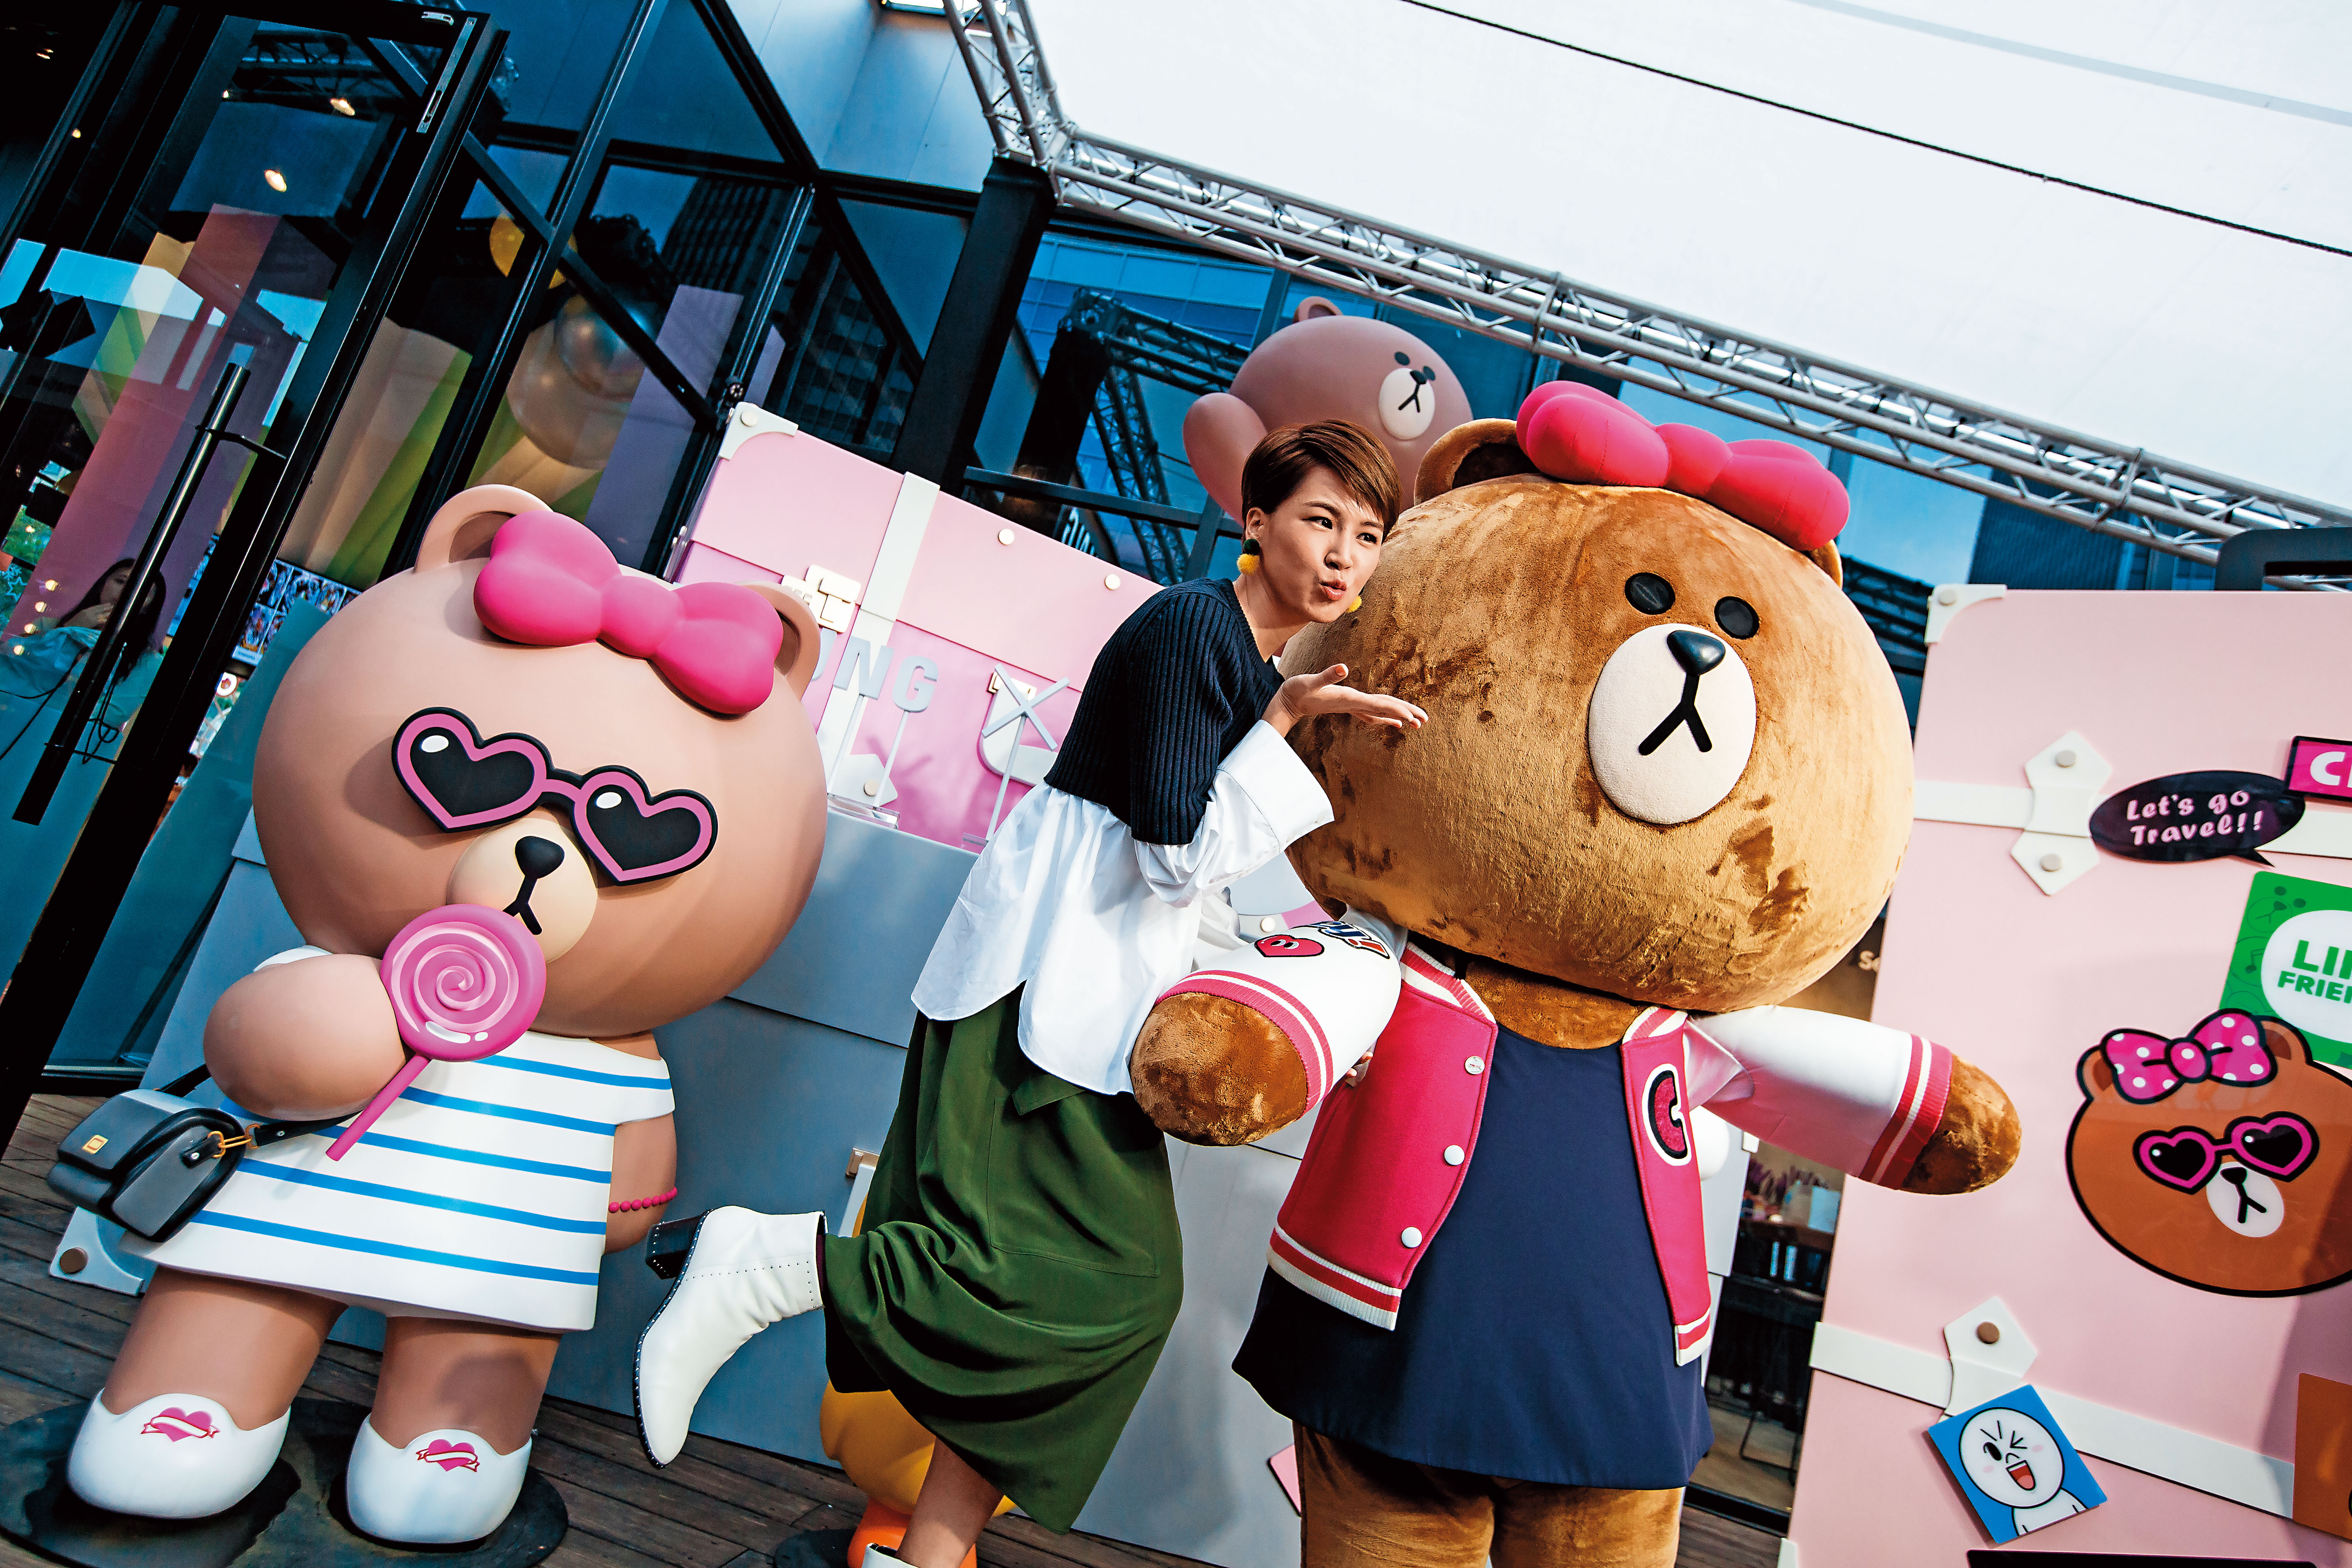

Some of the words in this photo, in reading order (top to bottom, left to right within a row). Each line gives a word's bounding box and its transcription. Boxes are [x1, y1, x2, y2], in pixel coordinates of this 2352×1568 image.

[2310, 751, 2352, 788] C
[2126, 793, 2195, 822] Let's
[2207, 790, 2251, 815] go
[2129, 810, 2264, 846] Travel!!
